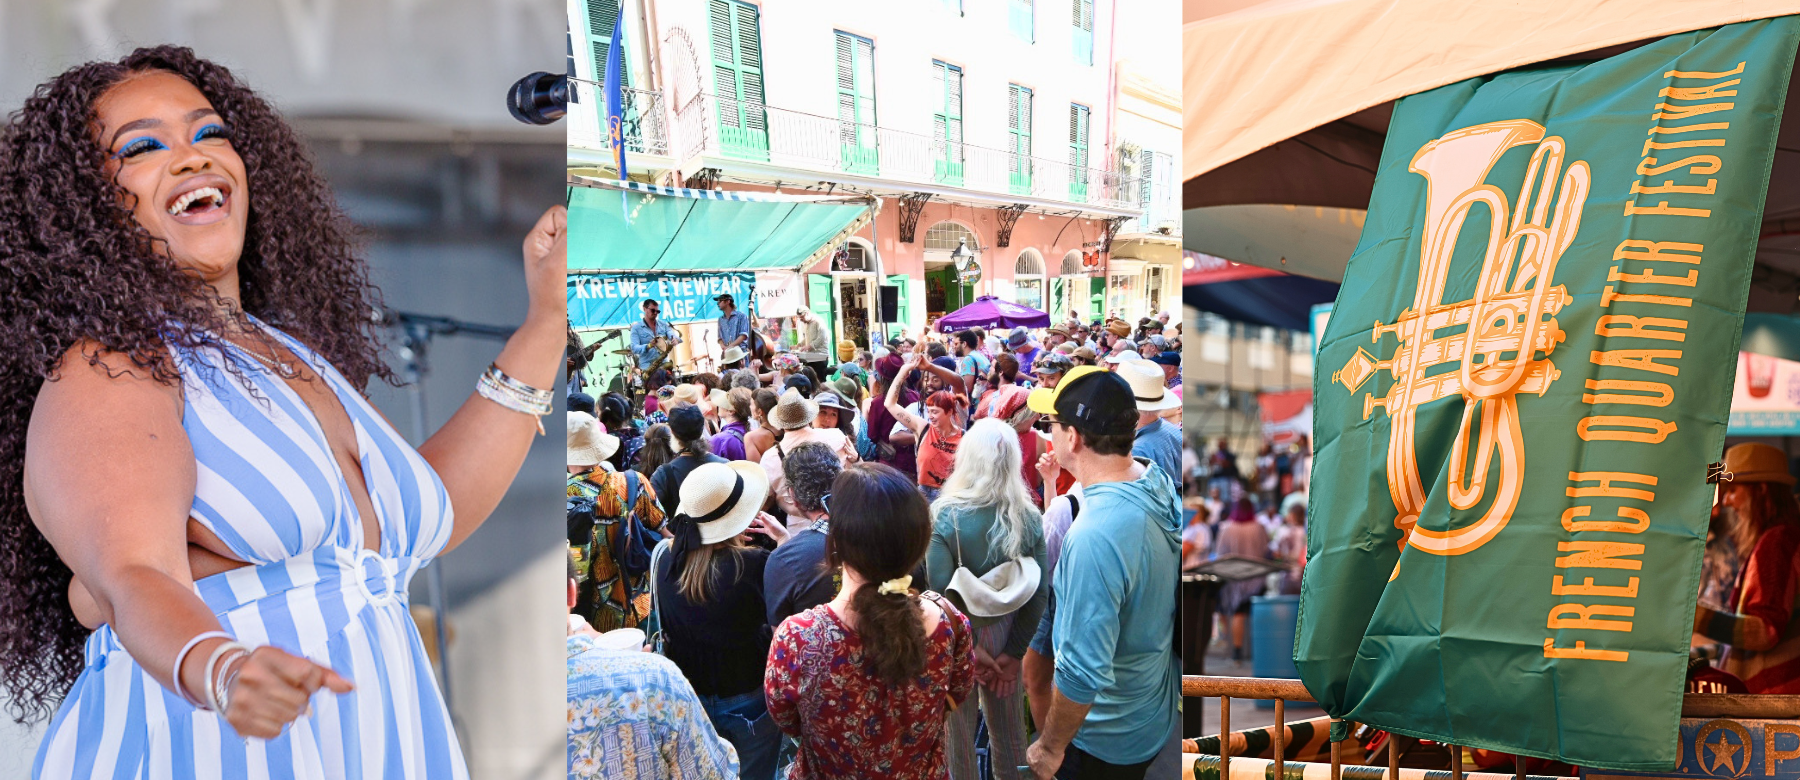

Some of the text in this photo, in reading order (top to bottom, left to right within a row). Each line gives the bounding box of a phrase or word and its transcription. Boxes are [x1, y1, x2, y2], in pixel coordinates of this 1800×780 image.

[575, 275, 742, 299] KREWE EYEWEAR
[1543, 61, 1746, 662] FRENCH QUARTER FESTIVAL
